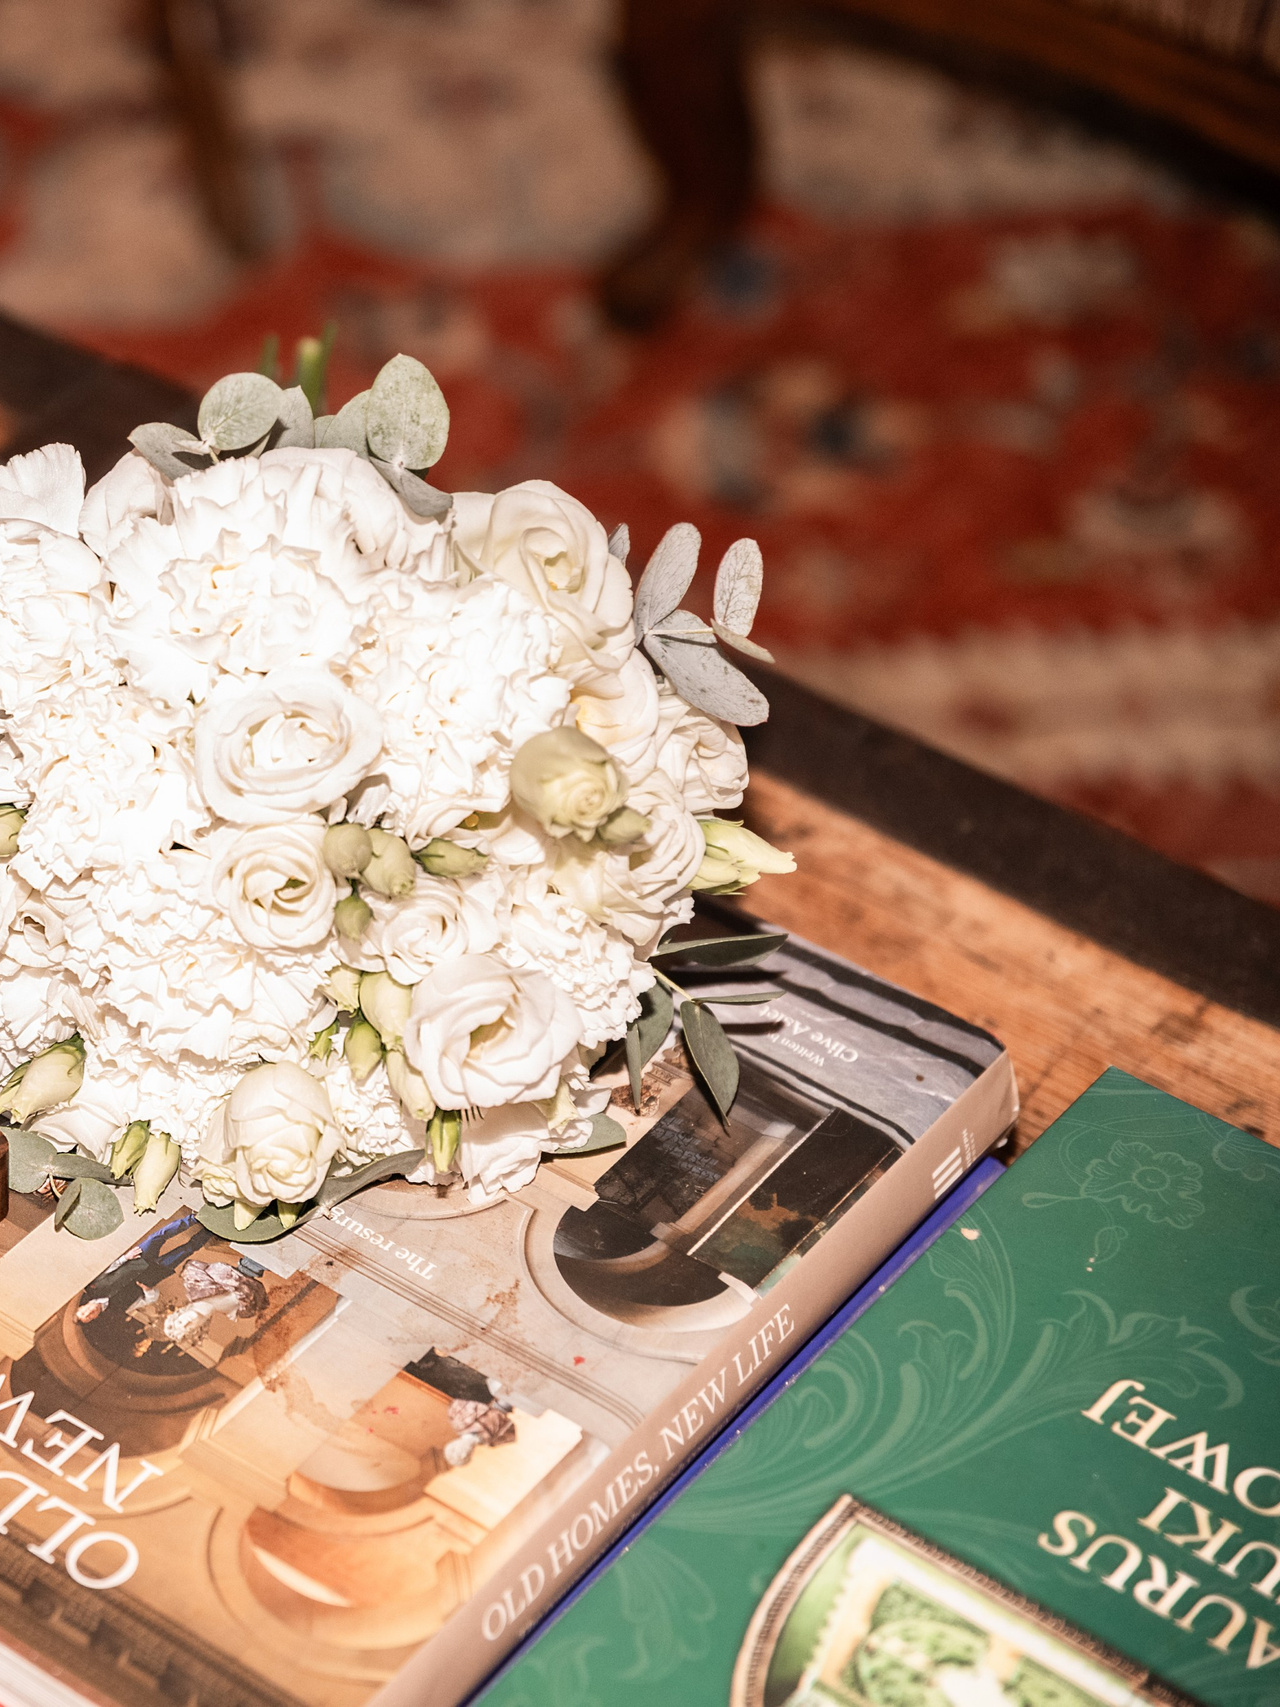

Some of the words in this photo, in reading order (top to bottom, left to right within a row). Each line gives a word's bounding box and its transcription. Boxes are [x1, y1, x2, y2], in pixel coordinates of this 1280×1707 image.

[781, 1038, 825, 1067] Written
[810, 1032, 859, 1062] Clive
[395, 1247, 438, 1280] The
[482, 1563, 545, 1641] OLD
[547, 1452, 660, 1578] HOMES,
[659, 1367, 728, 1461] NEW
[732, 1304, 795, 1386] LIFE
[1137, 1487, 1280, 1606] UKI
